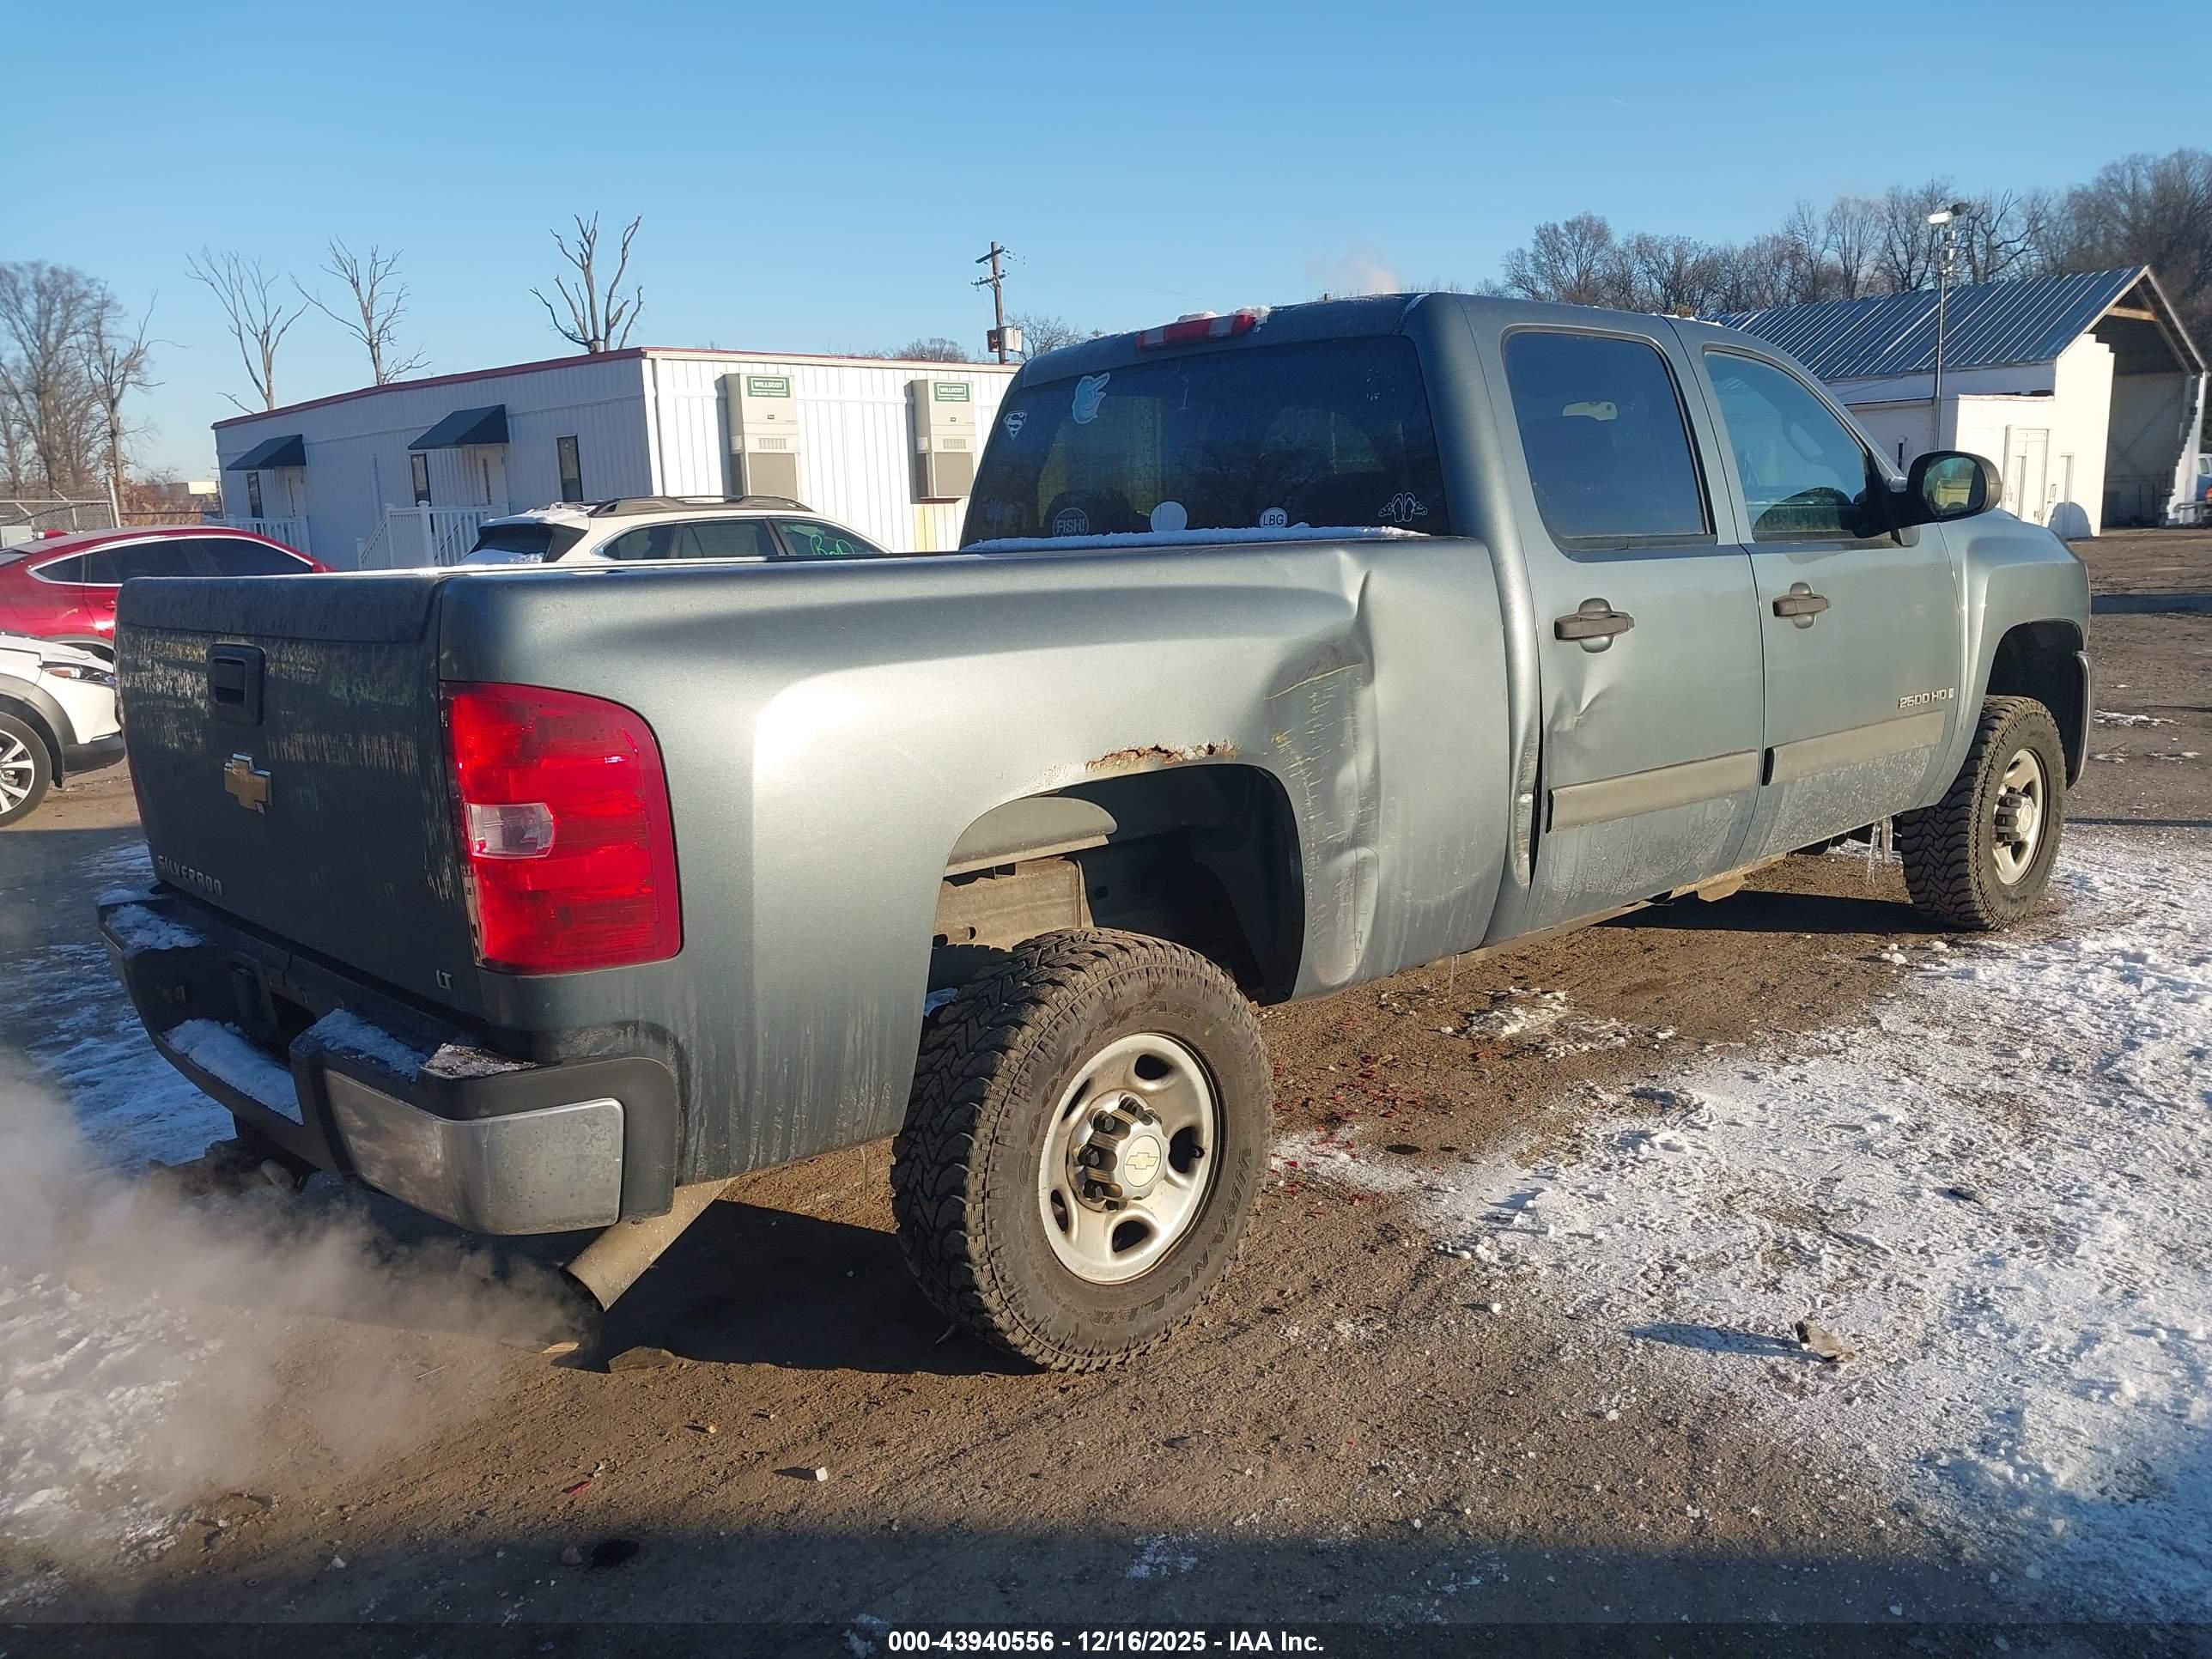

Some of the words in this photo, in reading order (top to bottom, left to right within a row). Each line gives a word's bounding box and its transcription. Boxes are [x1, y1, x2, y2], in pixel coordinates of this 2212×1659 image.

[1262, 514, 1284, 526] LBG
[1899, 693, 1929, 708] 2500
[157, 854, 223, 896] SILVERADO
[435, 969, 453, 993] LT
